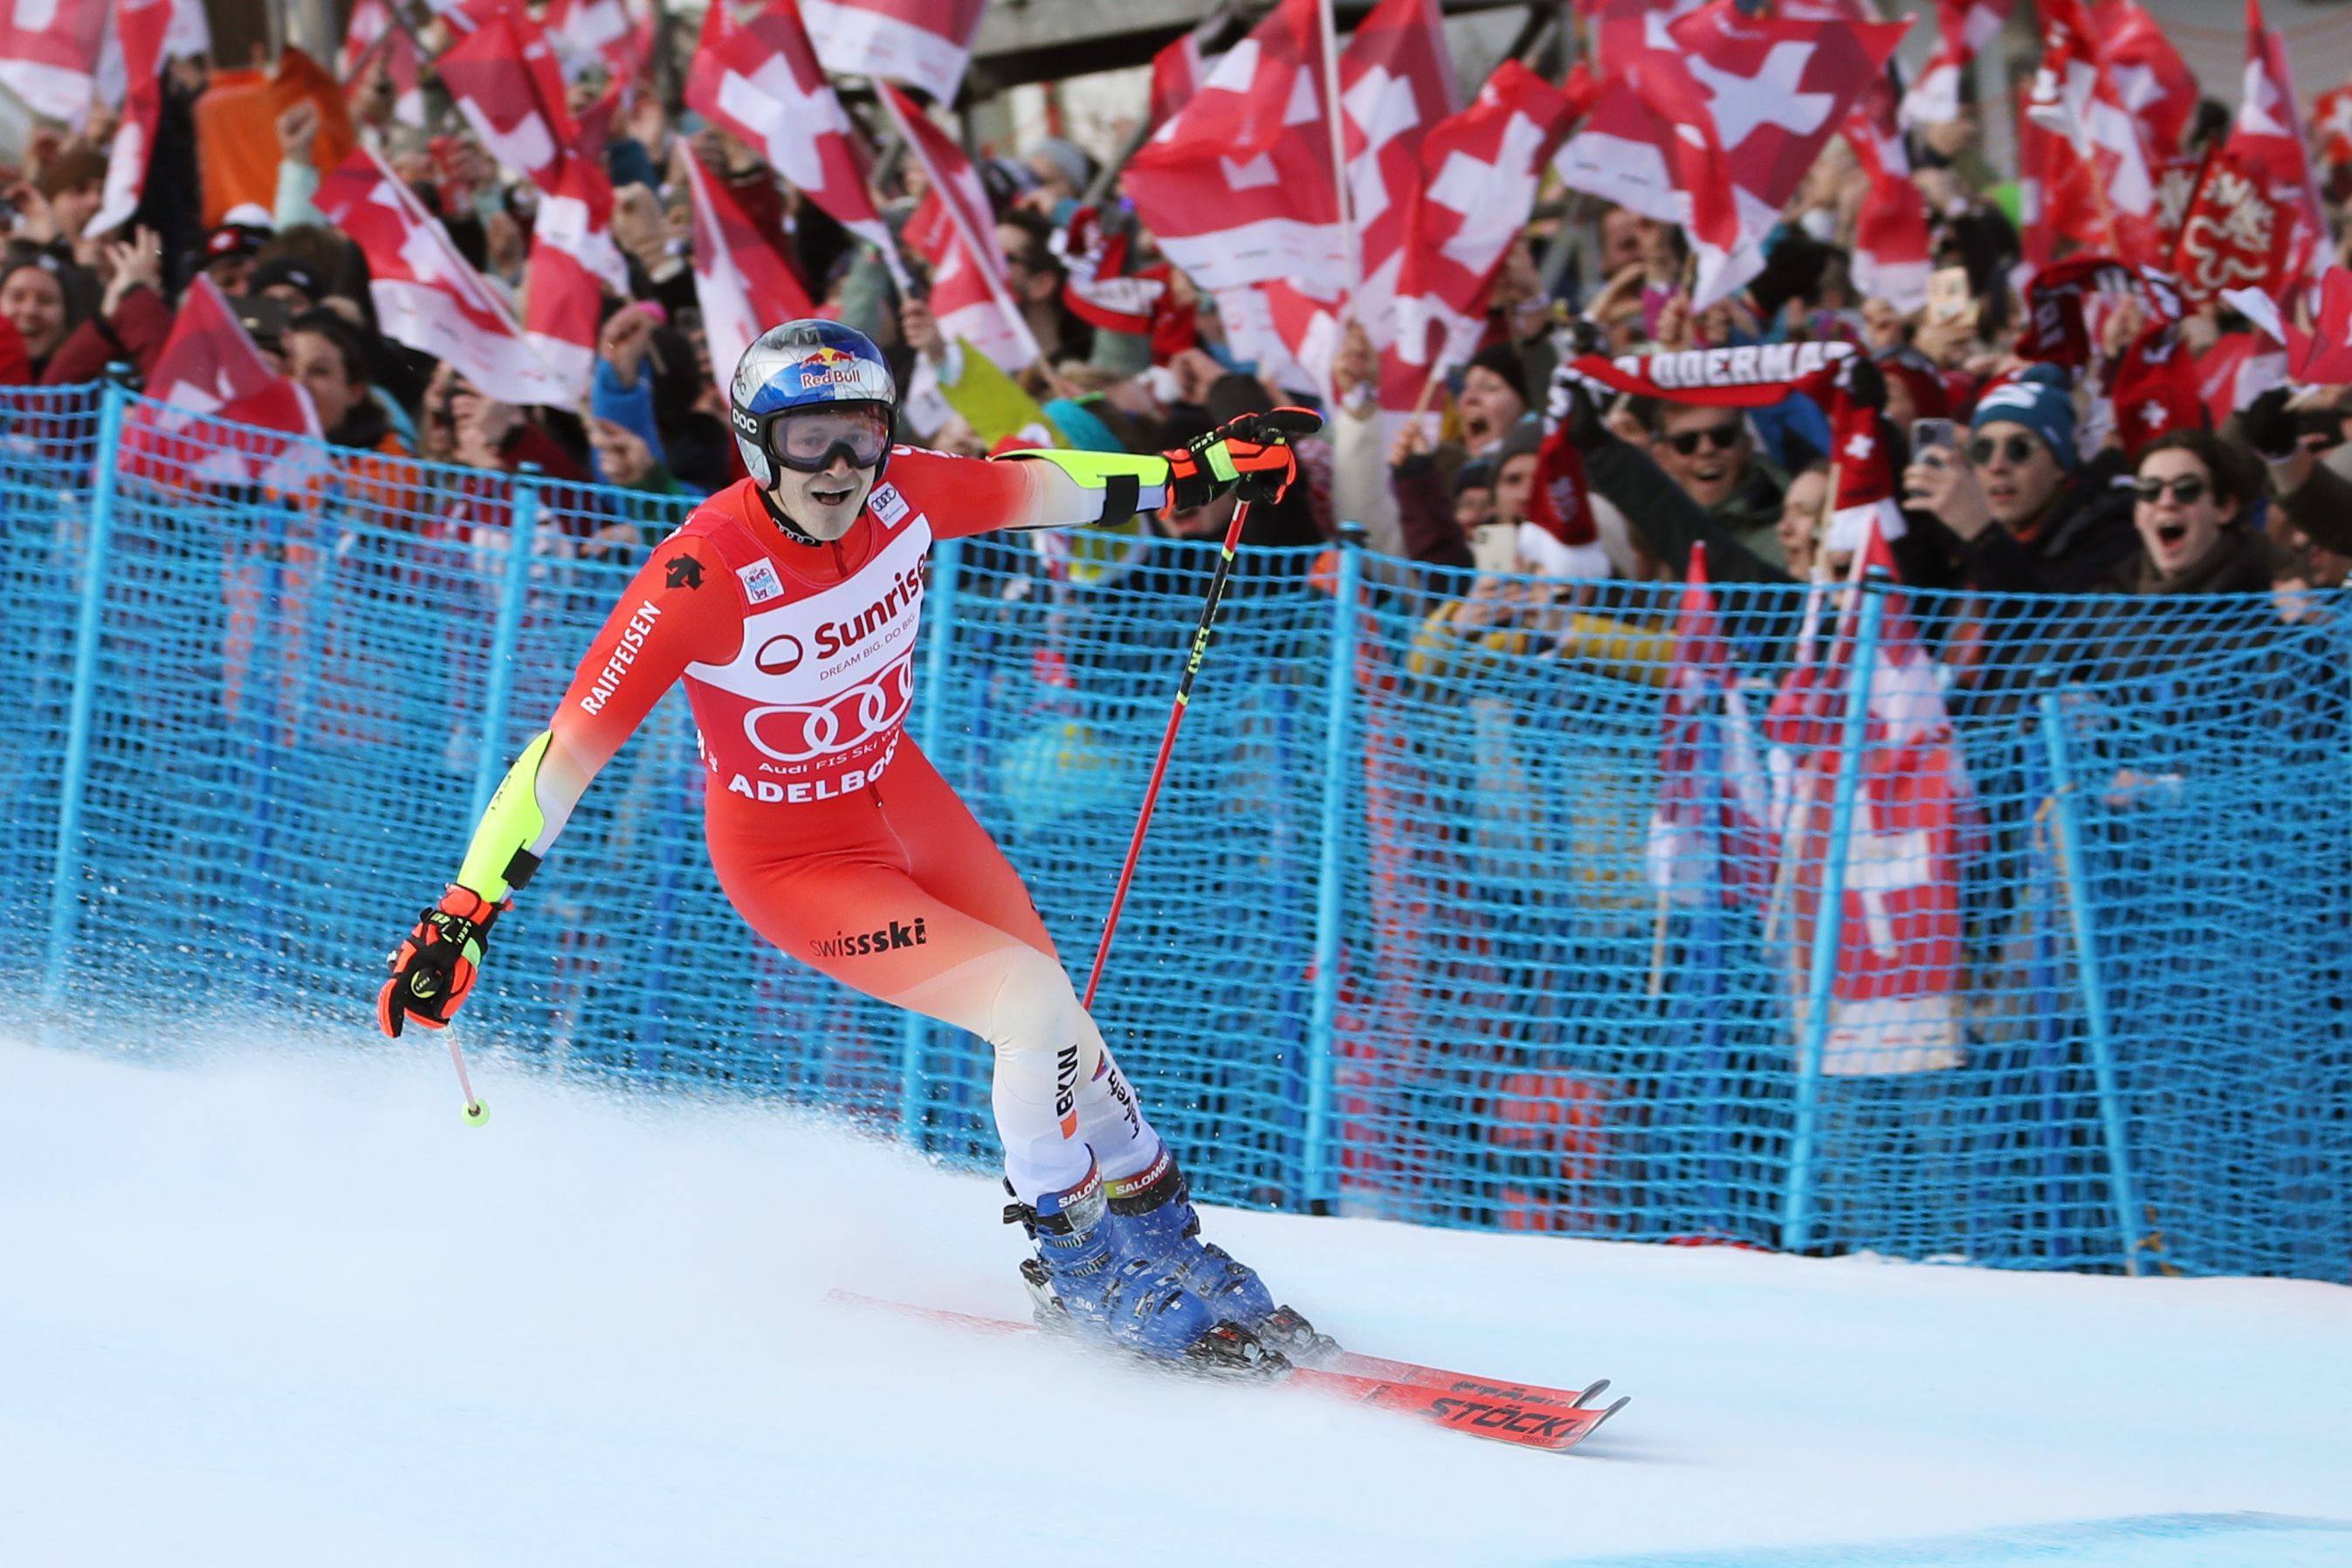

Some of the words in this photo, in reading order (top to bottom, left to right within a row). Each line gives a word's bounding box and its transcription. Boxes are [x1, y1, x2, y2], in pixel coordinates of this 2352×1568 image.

[801, 372, 830, 389] Red
[834, 369, 861, 383] Bull
[815, 553, 925, 660] Sunrise
[580, 600, 662, 716] RAIFFEISEN
[819, 653, 861, 681] DREAM
[884, 627, 901, 644] DO
[1187, 626, 1211, 674] LEKI
[758, 762, 808, 774] Audi
[815, 755, 848, 770] FIS
[809, 917, 927, 958] swissski
[1055, 1043, 1078, 1118] BKW
[1115, 1151, 1170, 1195] SALOMON
